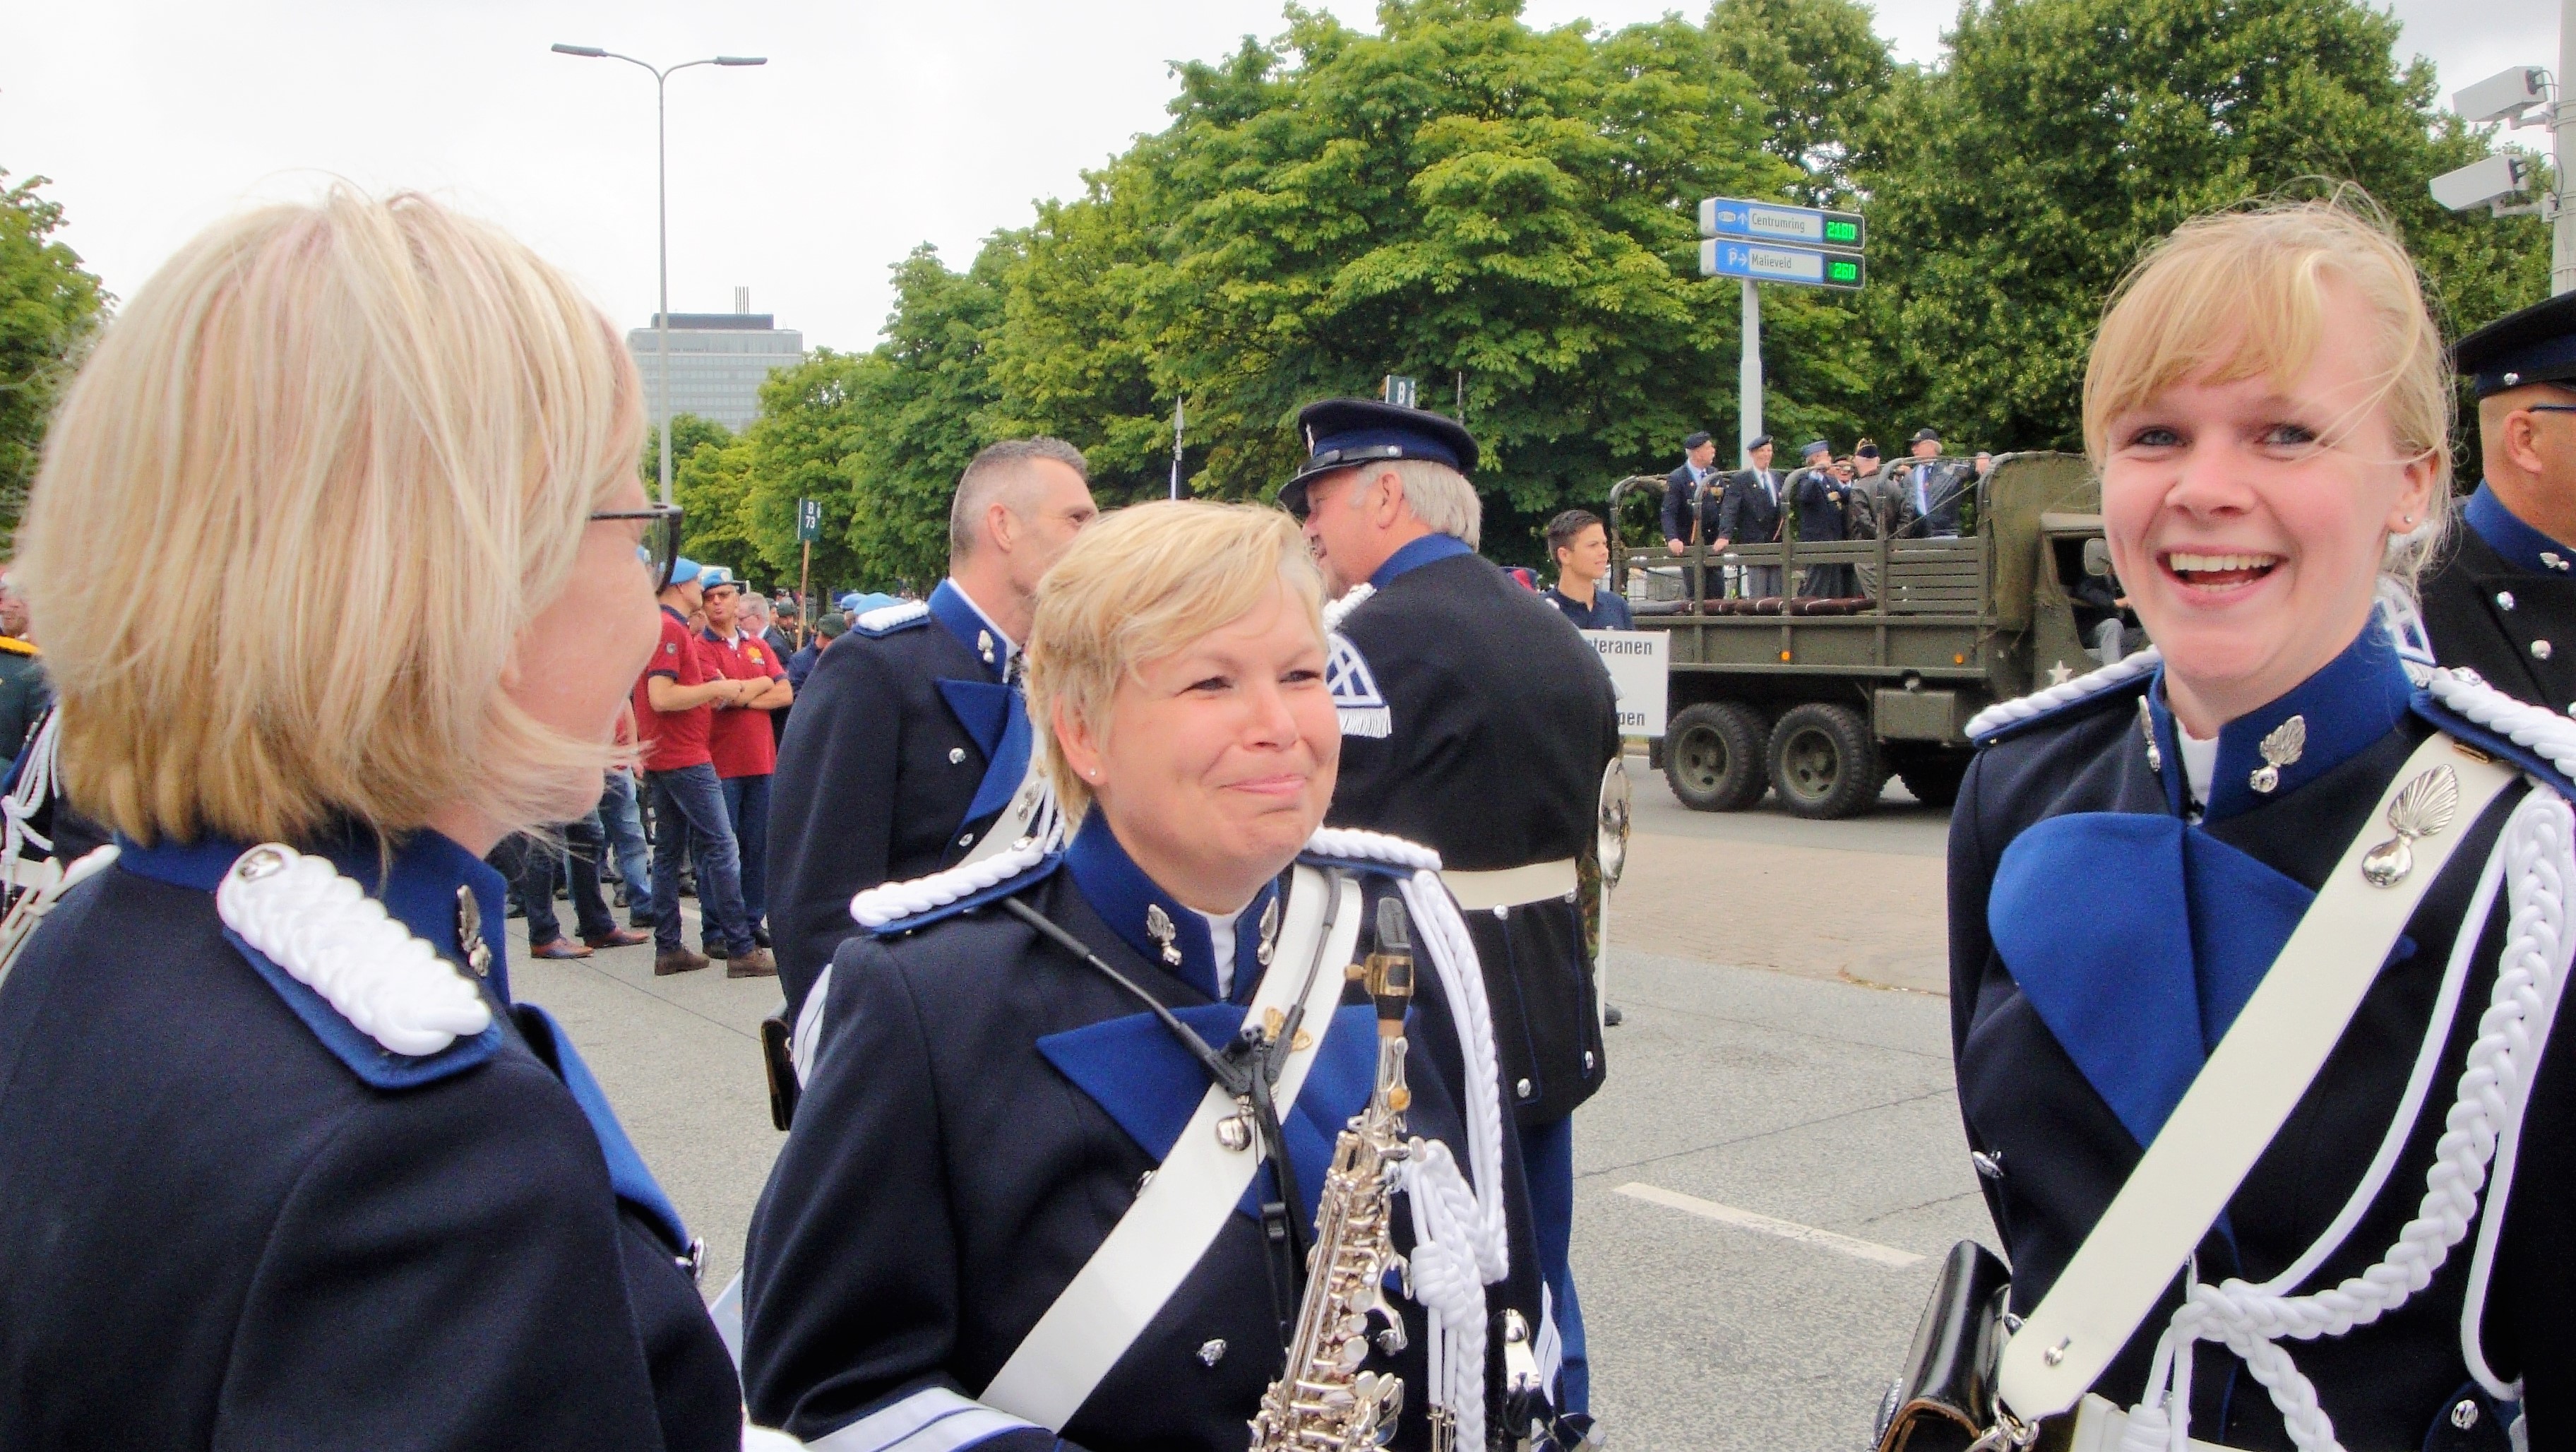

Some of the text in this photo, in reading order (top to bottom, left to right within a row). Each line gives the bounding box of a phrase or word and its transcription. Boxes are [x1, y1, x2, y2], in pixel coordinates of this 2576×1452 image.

[1752, 213, 1805, 233] Centrumring
[1752, 253, 1791, 269] Malieveld
[1834, 262, 1856, 280] 260
[805, 516, 816, 529] 73
[1588, 637, 1652, 655] teranen
